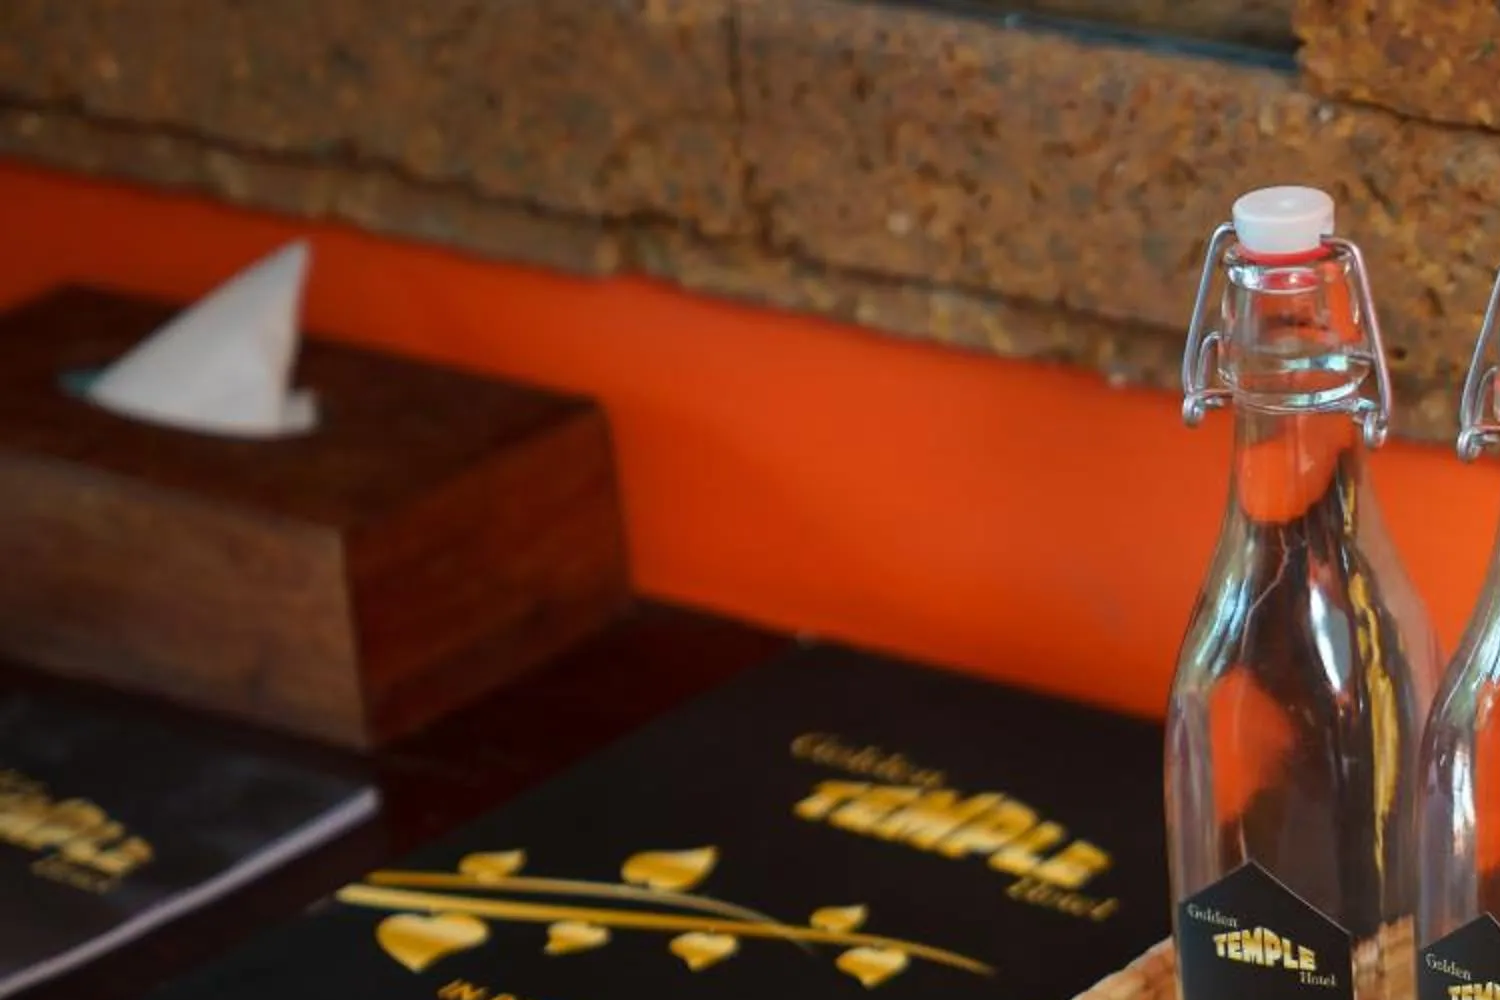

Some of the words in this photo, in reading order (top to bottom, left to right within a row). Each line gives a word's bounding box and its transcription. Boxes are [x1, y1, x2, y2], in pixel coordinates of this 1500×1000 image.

[794, 779, 1110, 888] TEMPLE
[1187, 902, 1237, 927] Golden
[1212, 926, 1316, 971] TEMPLE
[1300, 970, 1337, 986] Hotel
[1425, 953, 1471, 980] Golden
